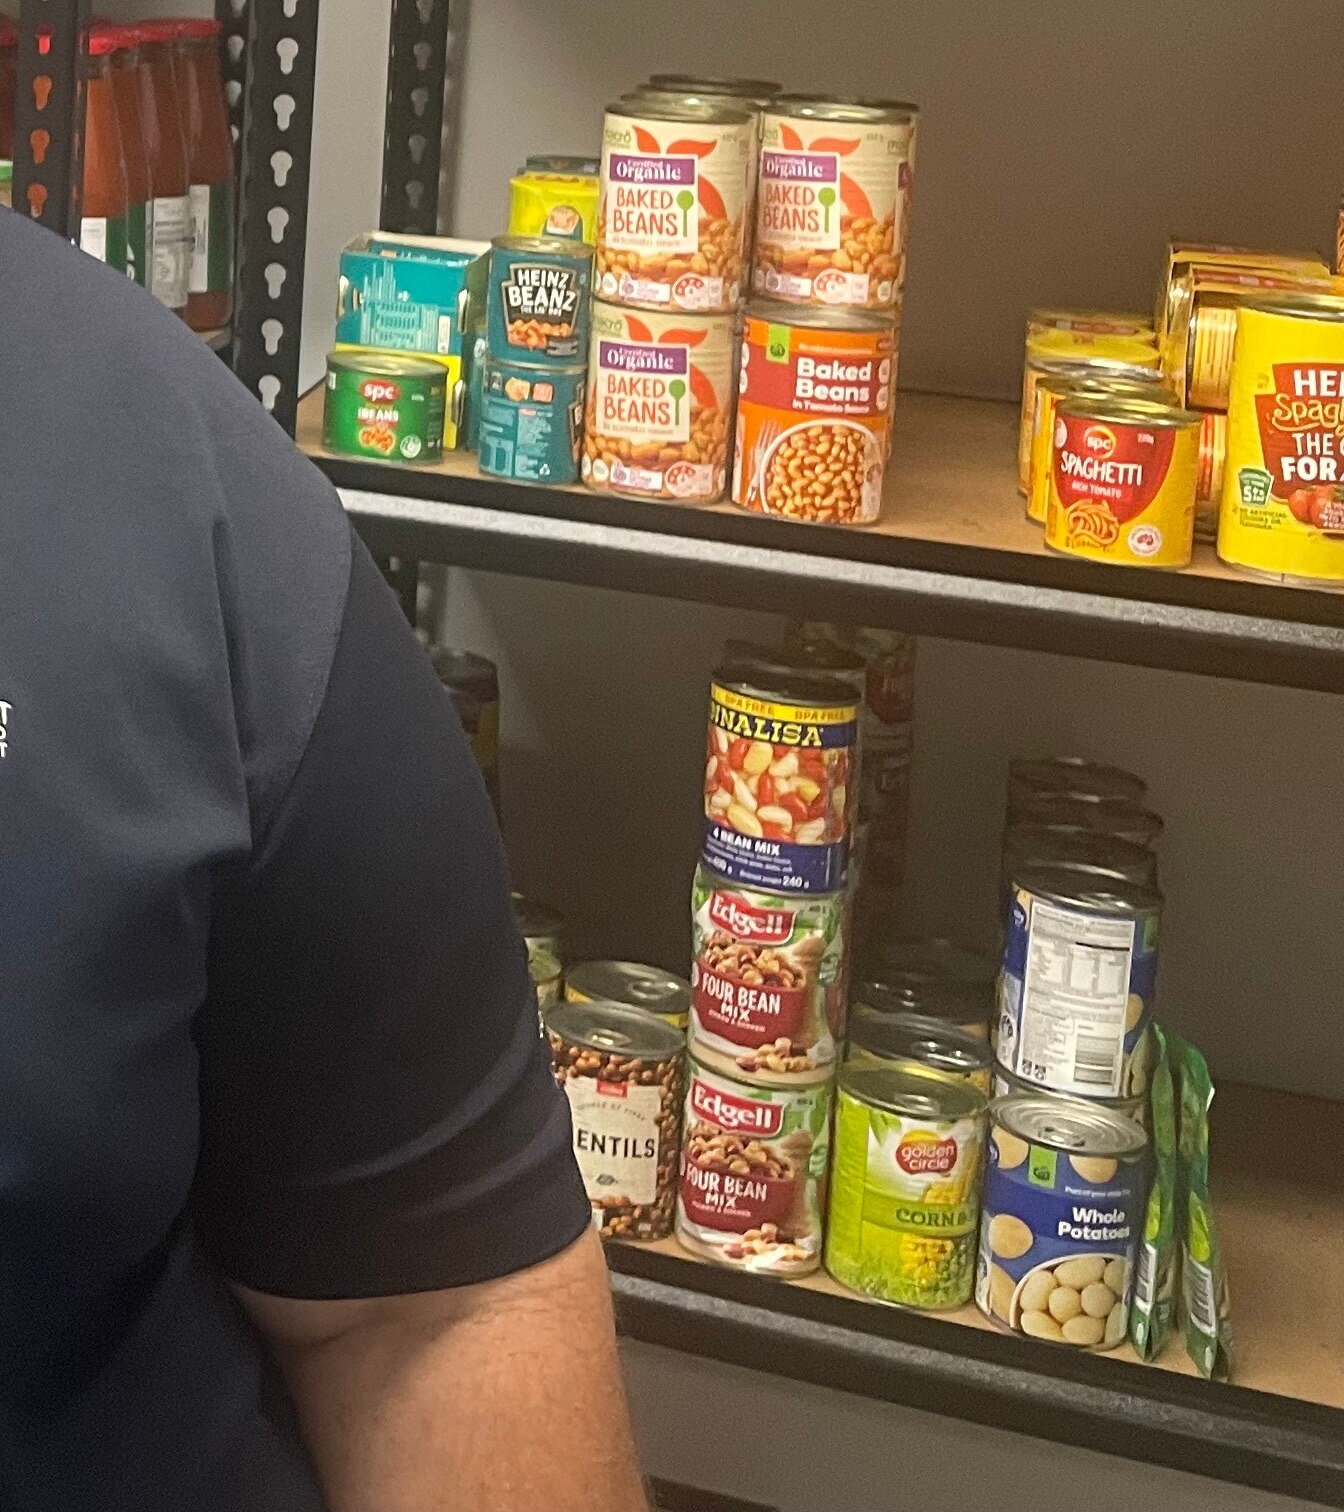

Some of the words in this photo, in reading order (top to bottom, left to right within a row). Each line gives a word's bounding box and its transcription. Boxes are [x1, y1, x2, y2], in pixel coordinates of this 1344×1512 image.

[616, 161, 682, 185] Organic
[766, 159, 824, 180] Organic
[616, 186, 674, 210] BAKED
[765, 182, 816, 206] BAKED
[613, 209, 679, 237] BEANS
[762, 206, 820, 234] BEANS
[517, 268, 570, 290] HEINZ
[508, 285, 577, 312] BEANZ
[607, 348, 674, 371] Organic
[796, 356, 872, 382] Baked
[364, 383, 396, 402] spc
[607, 373, 666, 398] BAKED
[795, 377, 870, 403] Beans
[604, 396, 671, 426] BEANS
[1086, 435, 1111, 451] spc
[1292, 432, 1334, 456] THE
[1060, 450, 1143, 486] SPAGHETTI
[1280, 455, 1338, 482] FOR
[745, 697, 775, 716] FREE
[721, 828, 752, 851] BEAN
[754, 838, 781, 857] MIX
[782, 874, 803, 888] 240
[712, 893, 784, 936] Edgell
[703, 972, 734, 1004] FOUR
[737, 985, 782, 1016] BEAN
[720, 1001, 752, 1023] MIX
[694, 1084, 773, 1129] Edgell
[576, 1128, 656, 1159] ENTILS
[901, 1144, 957, 1163] golden
[909, 1158, 951, 1172] circle
[687, 1162, 721, 1193] FOUR
[723, 1174, 768, 1202] BEAN
[705, 1191, 739, 1209] MIX
[895, 1207, 955, 1228] CORN
[1072, 1206, 1126, 1225] Whole
[1058, 1220, 1131, 1241] Potatoes
